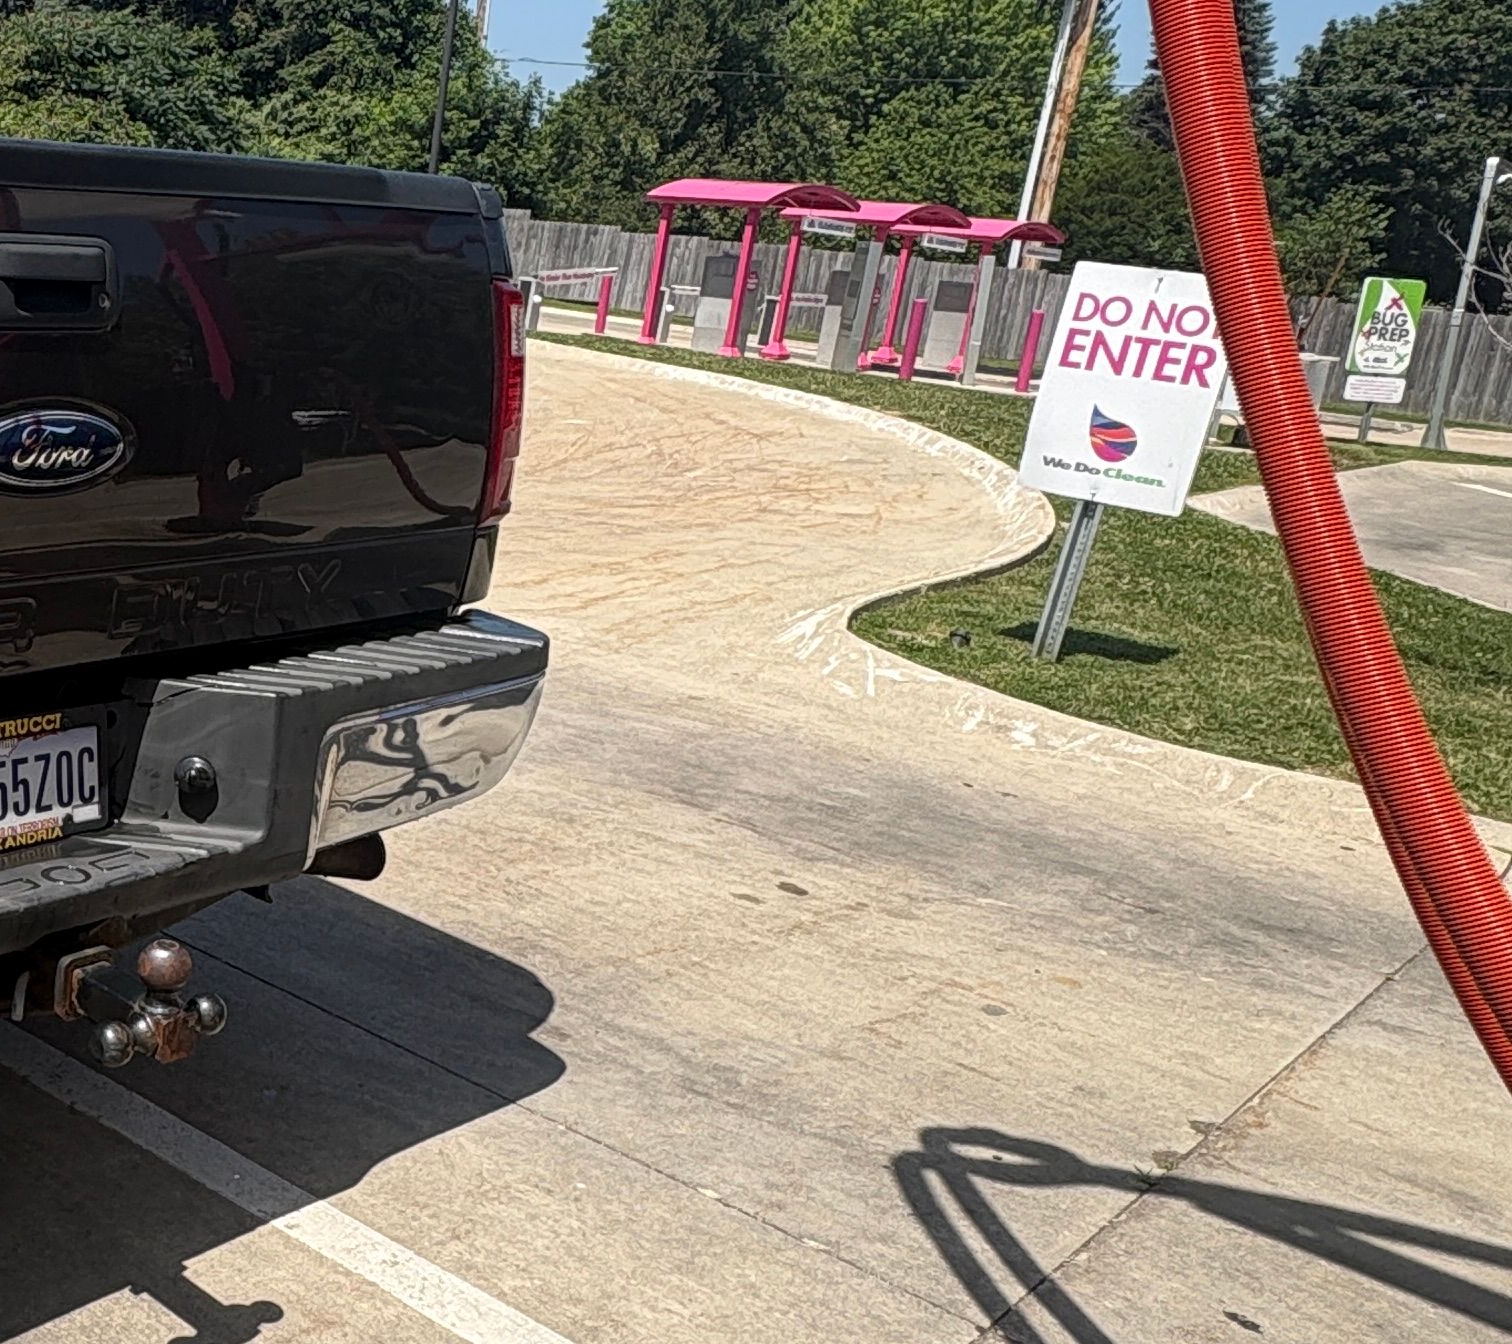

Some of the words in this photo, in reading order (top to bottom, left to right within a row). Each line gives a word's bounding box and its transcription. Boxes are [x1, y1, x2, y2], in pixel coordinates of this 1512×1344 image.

[1072, 292, 1133, 327] DO
[1141, 299, 1220, 339] NO
[1371, 311, 1408, 327] BUG
[1368, 327, 1409, 342] PREP
[1058, 328, 1217, 389] ENTER
[12, 424, 96, 471] Ford
[1043, 455, 1072, 471] We
[1074, 462, 1101, 475] Do
[110, 559, 343, 638] DUTY
[7, 825, 18, 836] ON
